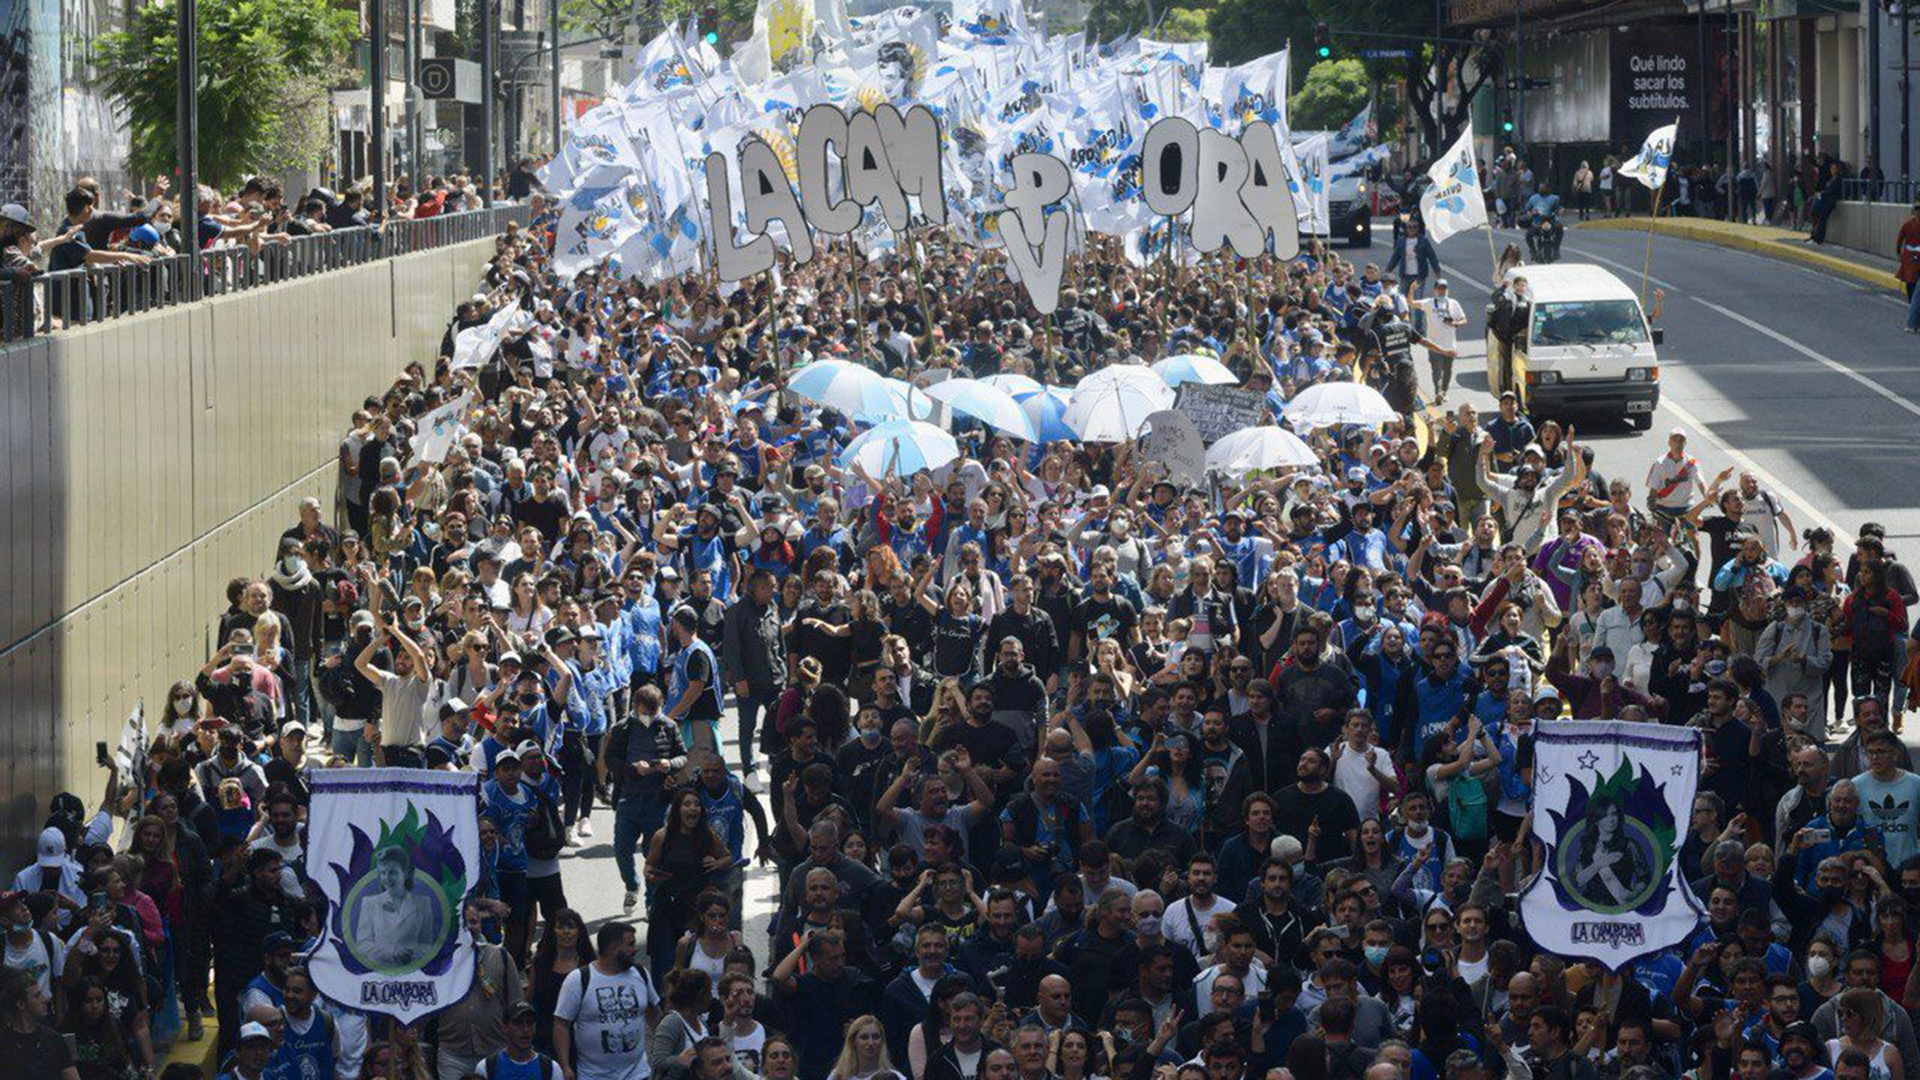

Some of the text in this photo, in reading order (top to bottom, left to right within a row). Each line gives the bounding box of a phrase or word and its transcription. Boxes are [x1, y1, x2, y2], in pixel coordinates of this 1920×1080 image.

[1630, 55, 1686, 72] Qué lindo
[1633, 74, 1685, 90] sacar los
[1629, 92, 1690, 109] subtítulos.
[705, 139, 813, 283] LA
[1573, 922, 1589, 941] LA
[363, 983, 380, 1002] LA
